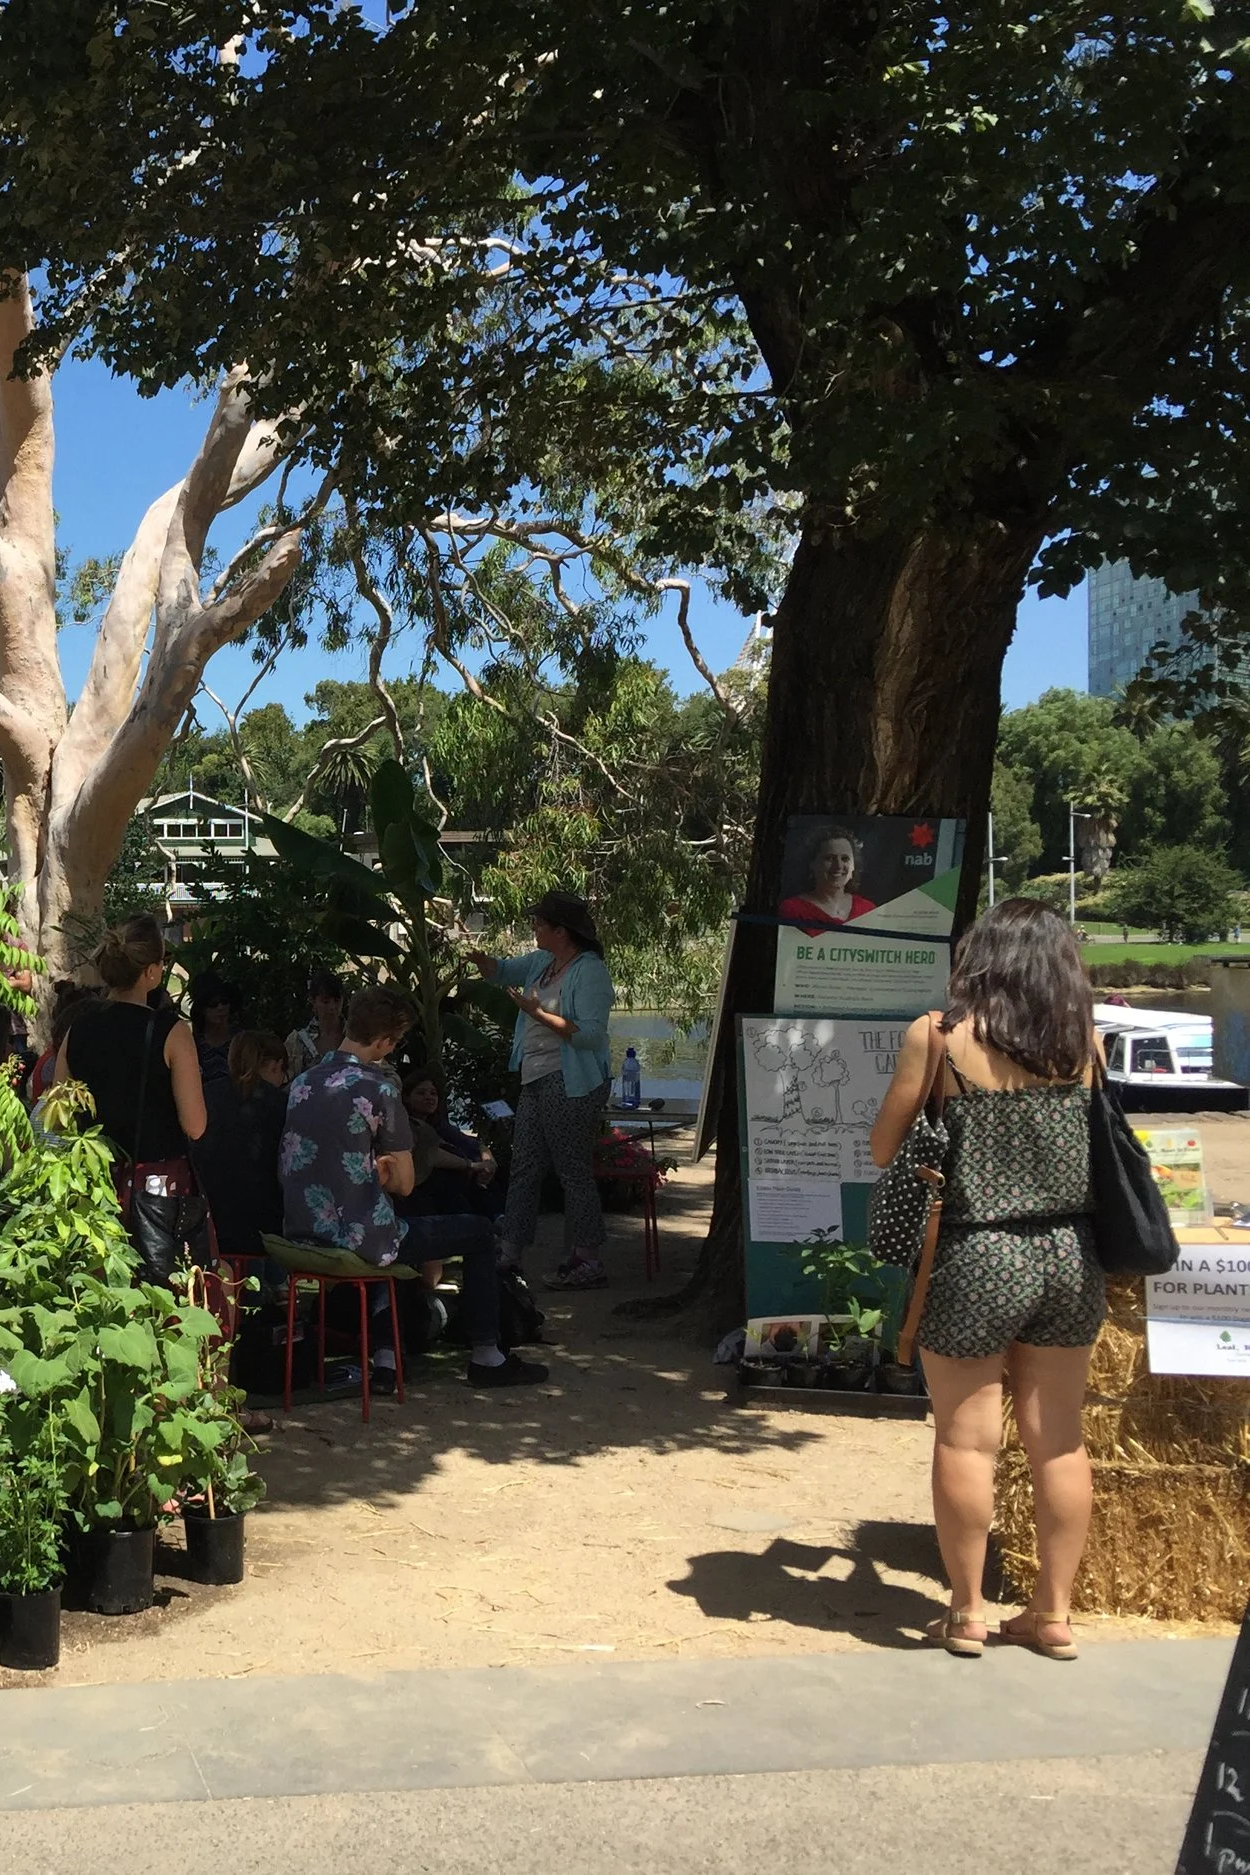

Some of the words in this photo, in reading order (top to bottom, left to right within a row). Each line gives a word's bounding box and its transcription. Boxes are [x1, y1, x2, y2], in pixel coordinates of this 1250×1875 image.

[904, 851, 933, 866] nab
[796, 945, 813, 960] BE
[817, 947, 825, 960] A
[830, 947, 901, 964] CITYSWITCH
[905, 950, 936, 964] HERO
[858, 1030, 886, 1050] THE
[889, 1030, 907, 1050] FO
[1175, 1260, 1193, 1272] IN
[1198, 1260, 1211, 1273] A
[1216, 1258, 1250, 1275] $10
[1153, 1282, 1188, 1294] FOR
[1194, 1284, 1250, 1296] PLANT
